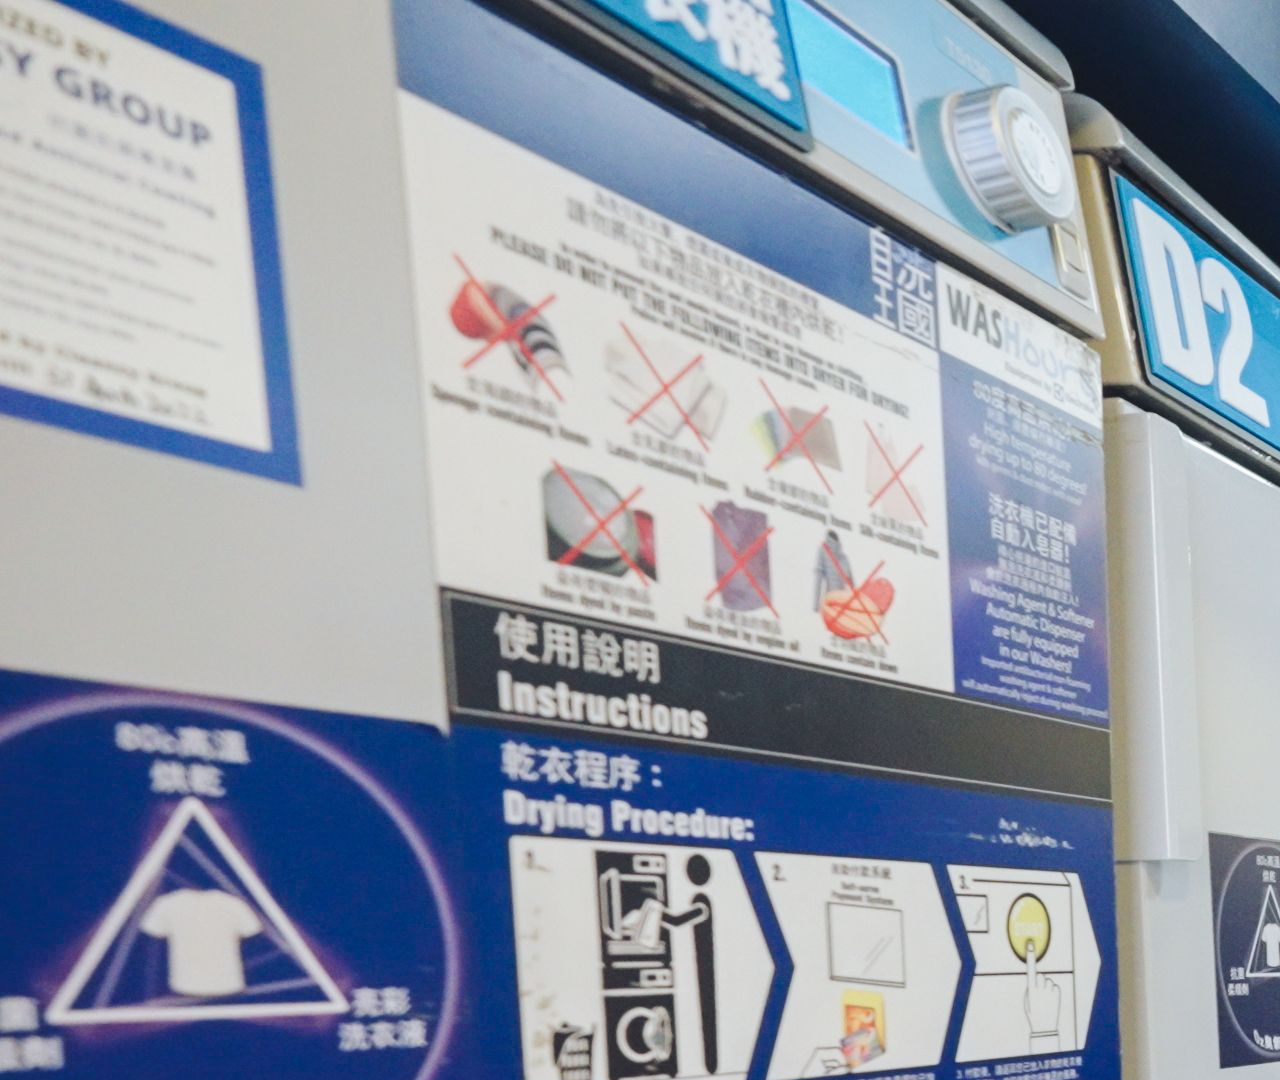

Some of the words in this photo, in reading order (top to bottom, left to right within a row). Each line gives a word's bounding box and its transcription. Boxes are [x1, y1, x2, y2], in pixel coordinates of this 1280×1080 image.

[53, 65, 212, 147] GROUP
[1131, 197, 1271, 429] D2
[493, 611, 662, 685] 使用說明
[496, 669, 709, 739] Instructions
[502, 788, 604, 837] Drying
[610, 799, 755, 841] Procedure:
